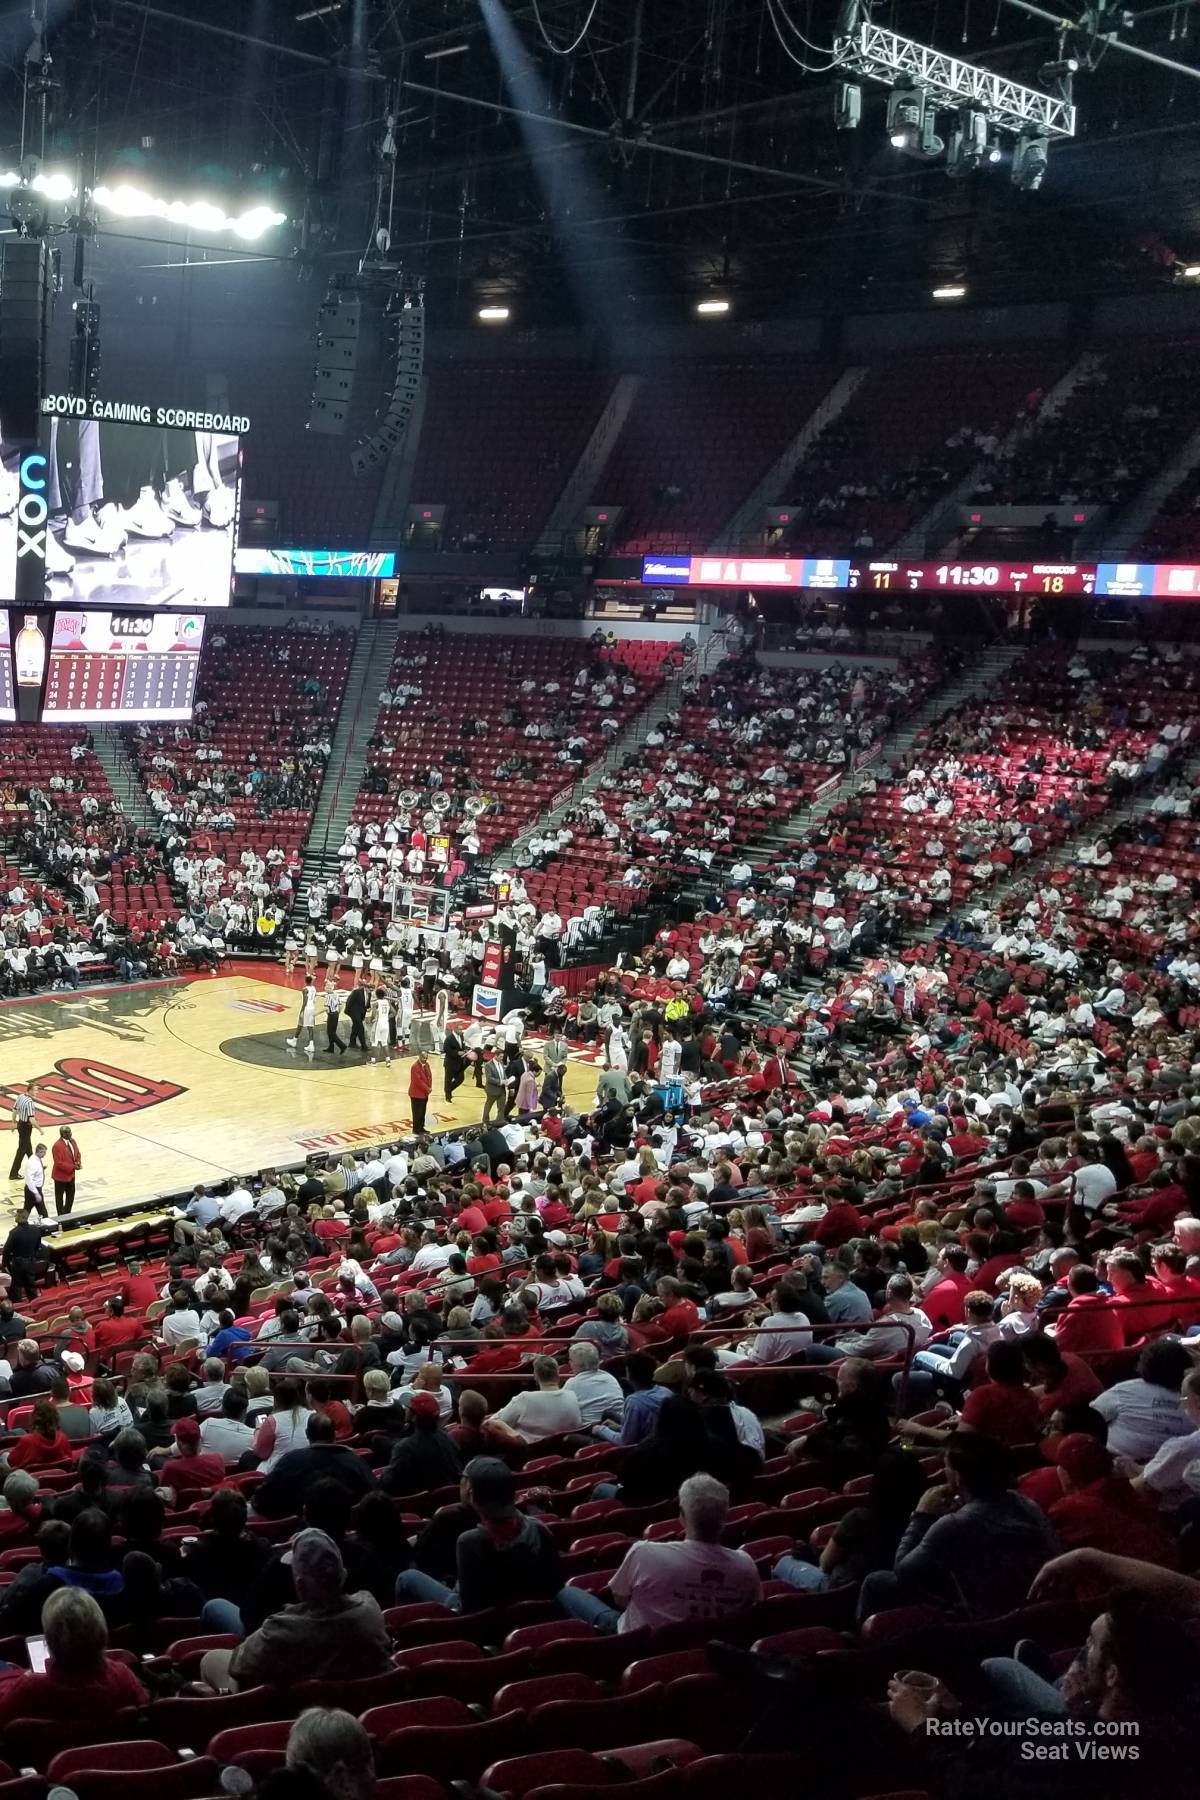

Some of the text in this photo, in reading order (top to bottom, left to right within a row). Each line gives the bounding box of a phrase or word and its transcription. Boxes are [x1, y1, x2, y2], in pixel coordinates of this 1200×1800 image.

[46, 394, 250, 433] BOYD GAMING SCOREBOARD
[18, 455, 48, 558] COX
[850, 577, 857, 587] 3
[874, 573, 890, 588] 11
[936, 566, 999, 585] 11:30
[910, 578, 918, 589] 3
[1014, 581, 1020, 591] 1
[1043, 577, 1063, 592] 18
[1083, 582, 1092, 593] 4
[112, 618, 152, 634] 11:30
